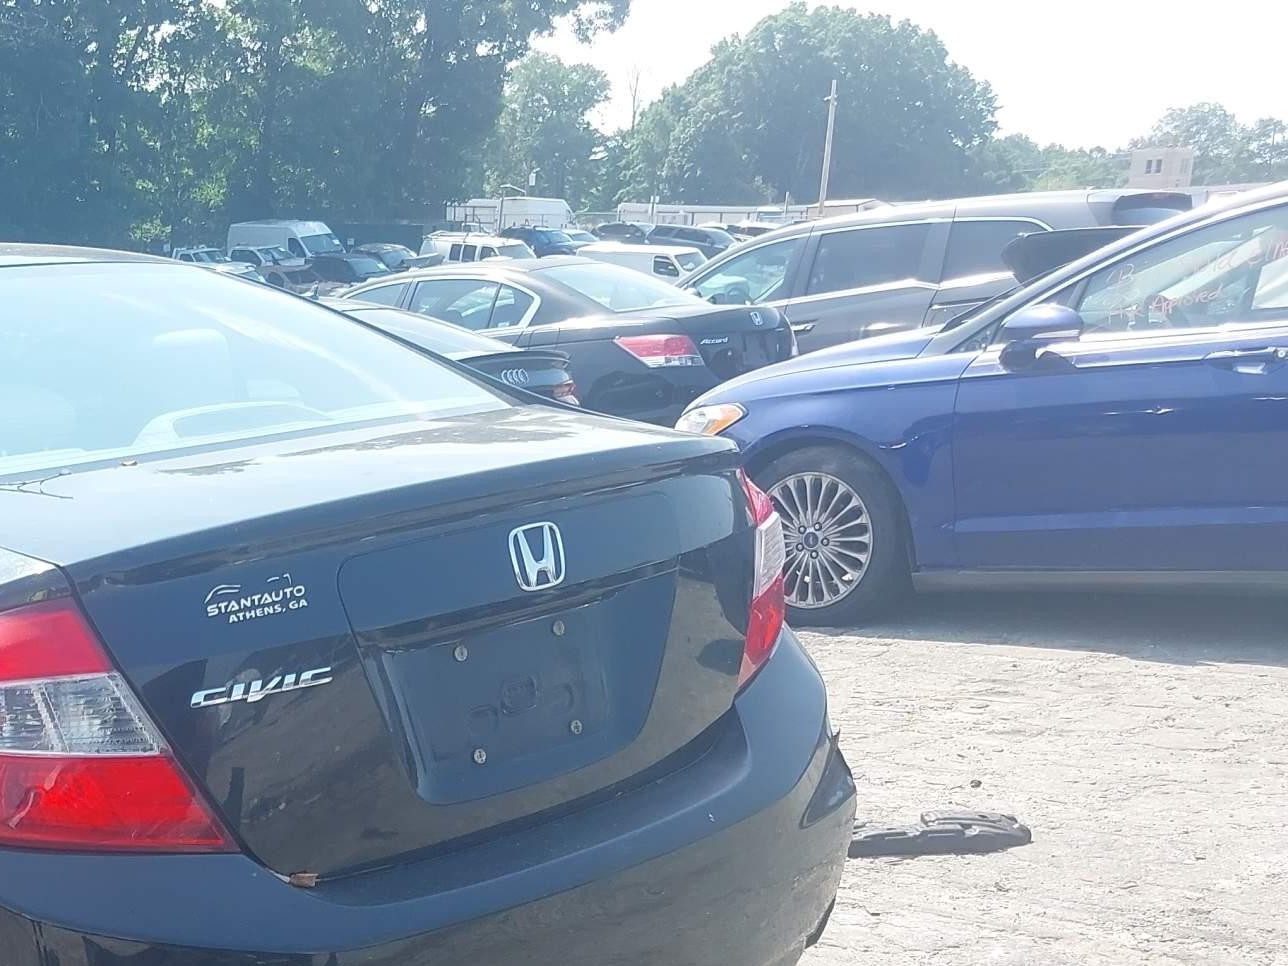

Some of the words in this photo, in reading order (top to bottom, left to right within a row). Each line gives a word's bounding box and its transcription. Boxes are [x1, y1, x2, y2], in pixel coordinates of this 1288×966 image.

[206, 585, 305, 617] STANTAUTO
[229, 603, 287, 624] ATHENS,
[288, 599, 308, 610] GA
[190, 666, 333, 709] CIVIC
